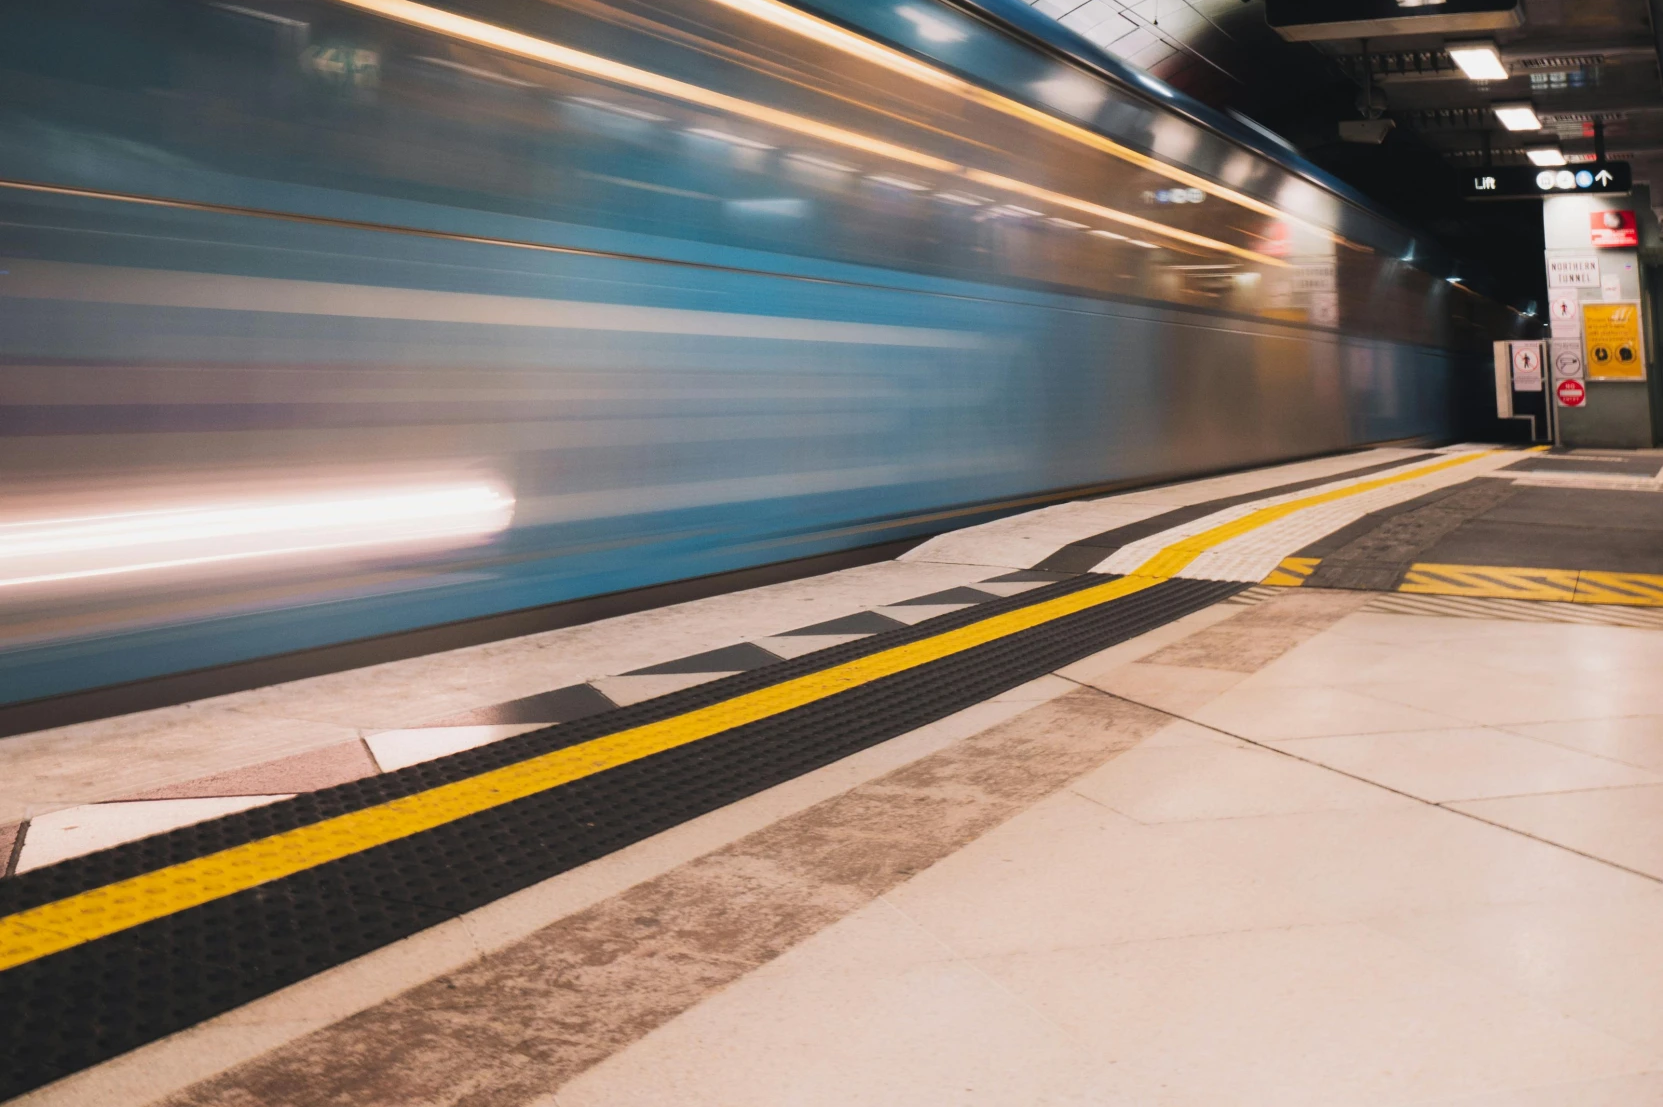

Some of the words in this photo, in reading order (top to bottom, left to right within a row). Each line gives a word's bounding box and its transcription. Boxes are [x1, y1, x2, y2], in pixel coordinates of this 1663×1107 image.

[1475, 176, 1496, 190] Lift
[1552, 261, 1596, 271] NORTHERN
[1558, 274, 1591, 283] TUNNEL
